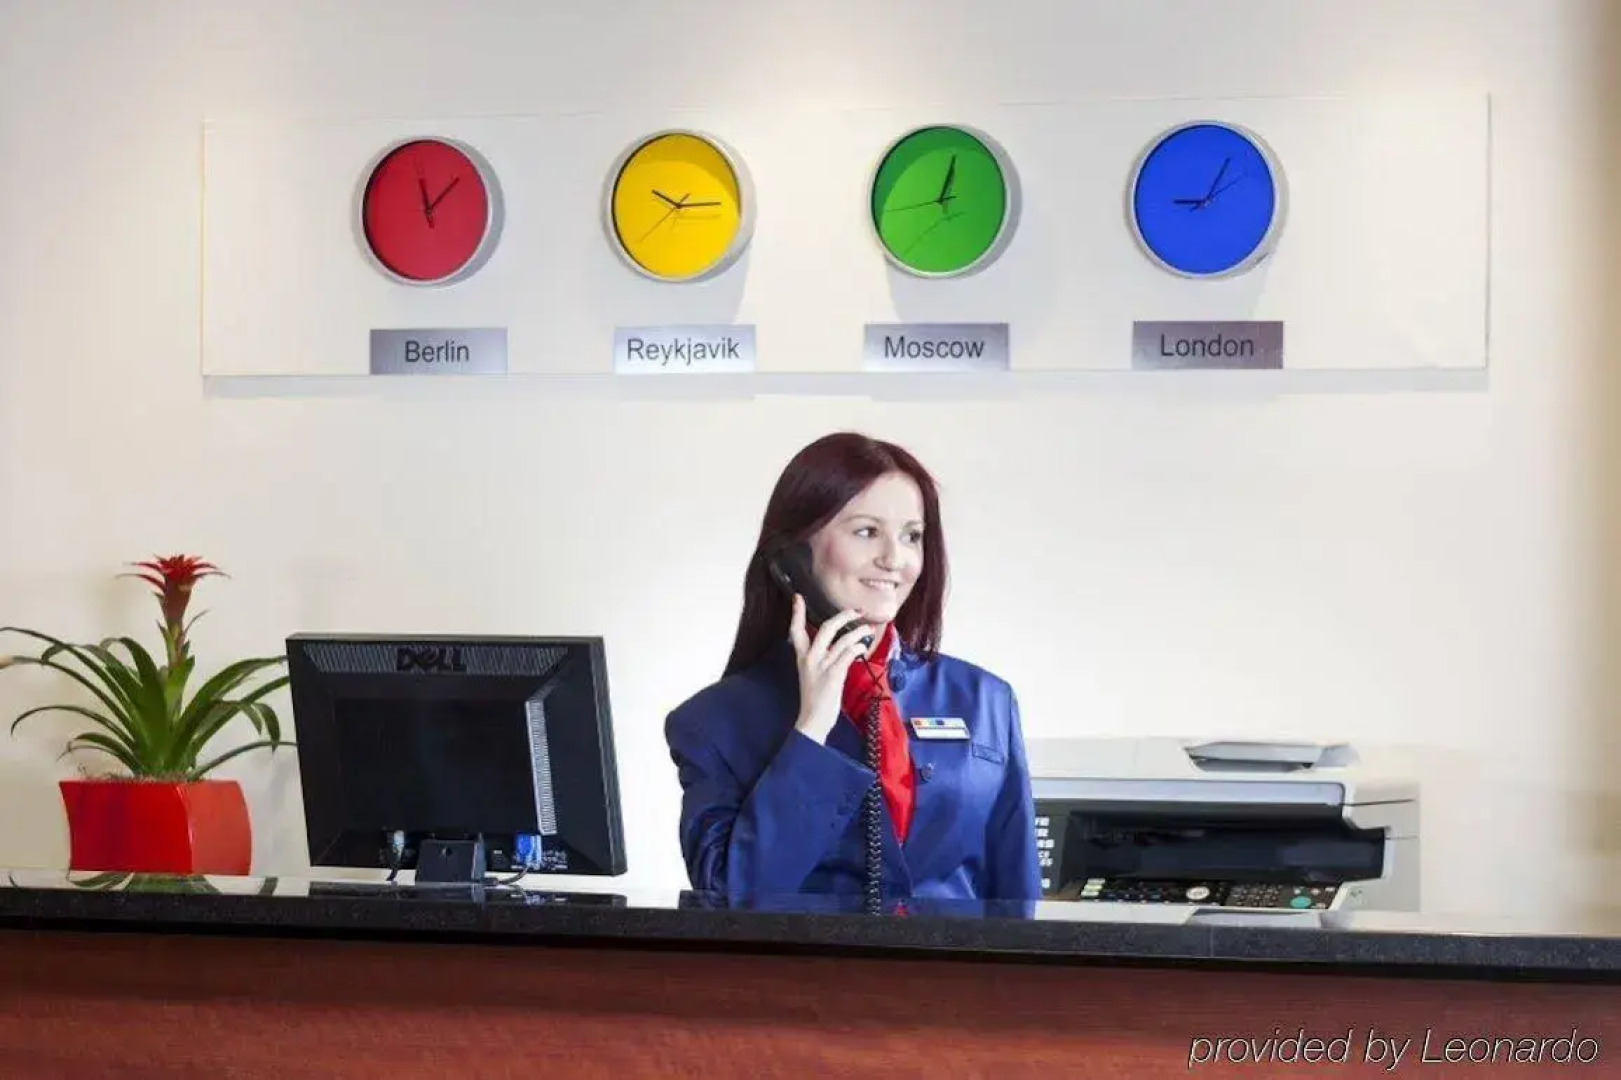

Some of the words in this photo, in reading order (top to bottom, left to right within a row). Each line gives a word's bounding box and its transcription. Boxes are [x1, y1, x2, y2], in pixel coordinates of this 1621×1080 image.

[404, 341, 470, 363] Berlin
[627, 337, 740, 365] Reykjavik
[884, 336, 985, 358] Moscow
[1160, 334, 1254, 357] London
[397, 647, 466, 672] DELL
